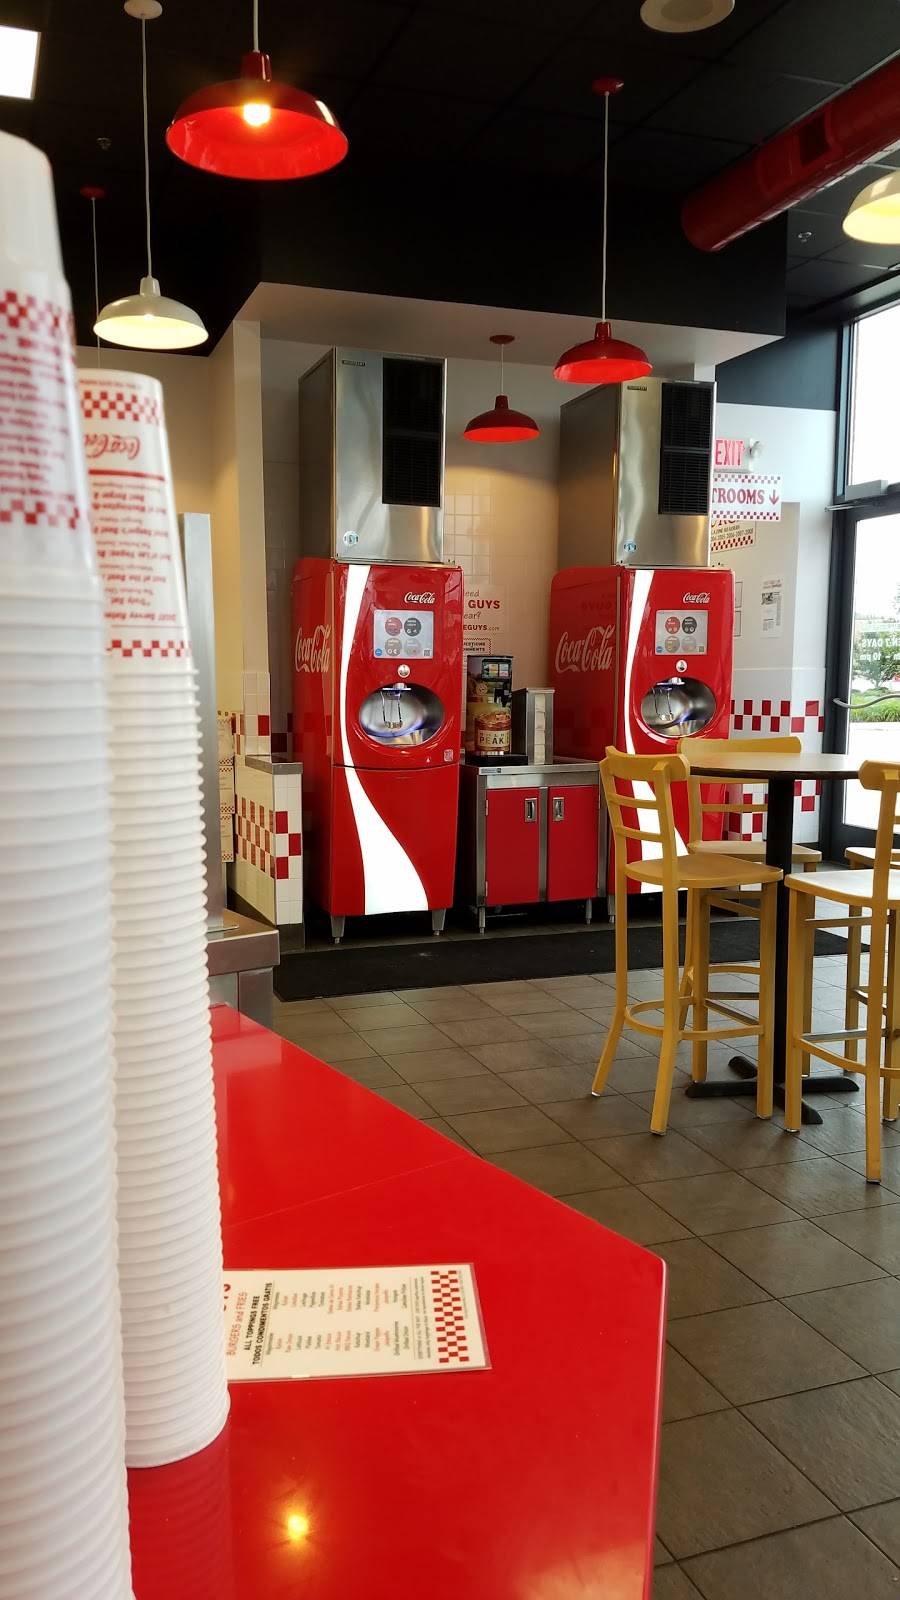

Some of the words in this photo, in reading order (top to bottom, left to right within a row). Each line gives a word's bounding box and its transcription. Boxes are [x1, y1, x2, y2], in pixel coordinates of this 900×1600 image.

[715, 439, 744, 466] EXIT
[467, 599, 501, 610] GUYS
[294, 624, 332, 673] Coca-Cola
[555, 624, 616, 674] Coca-Cola
[479, 737, 505, 746] PEAK
[251, 1295, 261, 1309] FREE
[263, 1282, 273, 1302] GRATIS
[246, 1310, 258, 1338] TOPPINGS
[256, 1303, 270, 1344] CONDIMENTOS
[243, 1340, 253, 1351] ALL
[252, 1345, 263, 1365] TODOS
